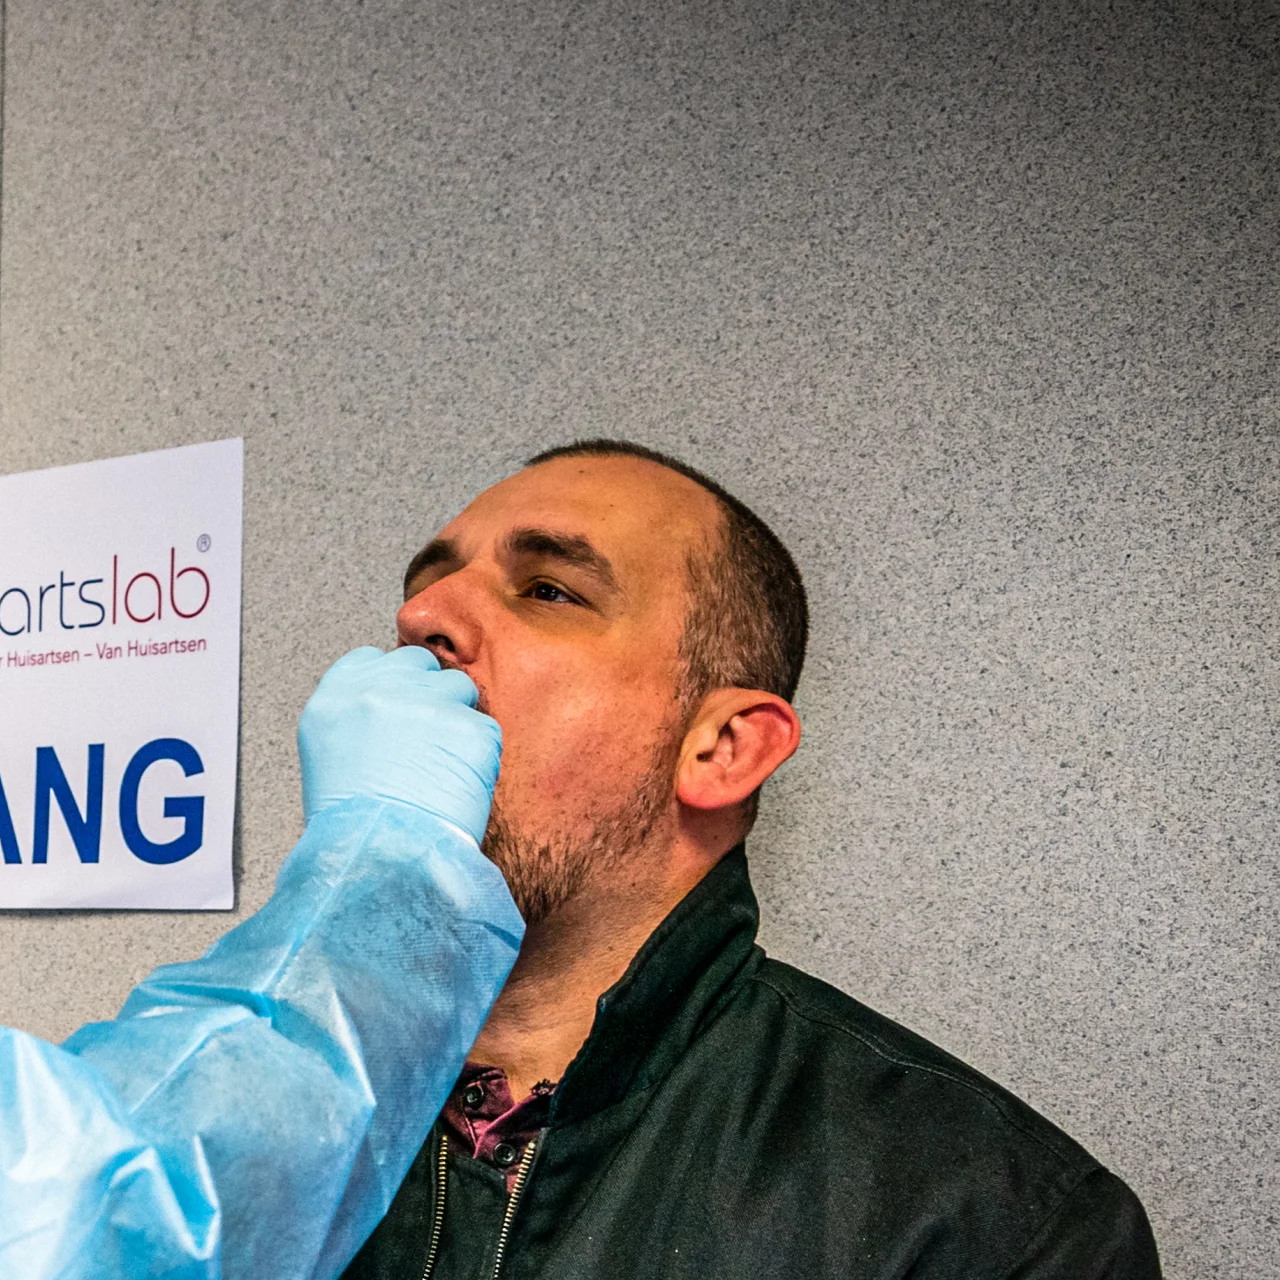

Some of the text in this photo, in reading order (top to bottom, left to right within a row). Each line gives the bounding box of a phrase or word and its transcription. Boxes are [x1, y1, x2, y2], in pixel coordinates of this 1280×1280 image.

[6, 648, 80, 669] Huisartsen
[95, 641, 123, 660] Van
[127, 637, 208, 658] Huisartsen
